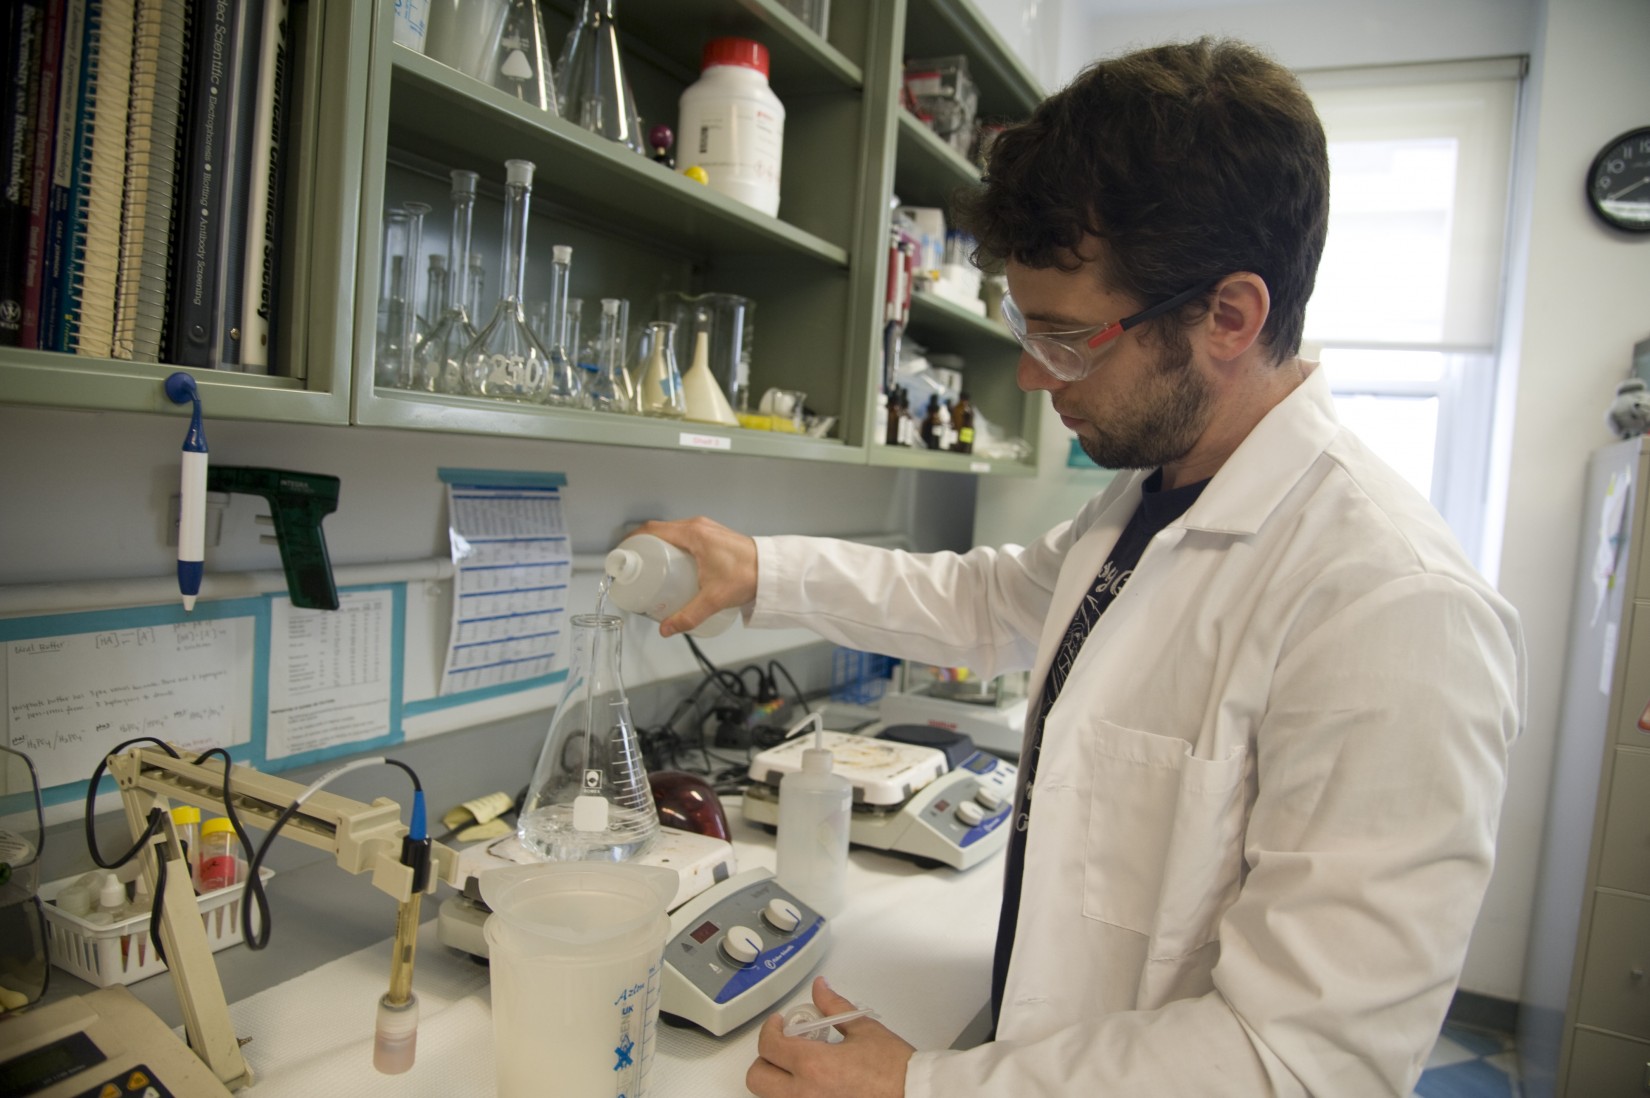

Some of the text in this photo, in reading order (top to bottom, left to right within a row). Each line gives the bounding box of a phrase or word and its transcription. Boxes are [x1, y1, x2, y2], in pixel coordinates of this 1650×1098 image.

[14, 3, 36, 86] Biochemistry
[211, 24, 226, 85] Scientific
[39, 70, 53, 131] Experimental
[65, 55, 78, 110] Experiments
[6, 113, 28, 204] Biotechnology
[36, 132, 48, 168] Organic
[58, 125, 72, 180] Microbiology
[31, 169, 46, 216] Chemistry
[194, 96, 217, 306] Electrophoresis Blotting Antibody Screening
[257, 43, 284, 321] American Chemical Society
